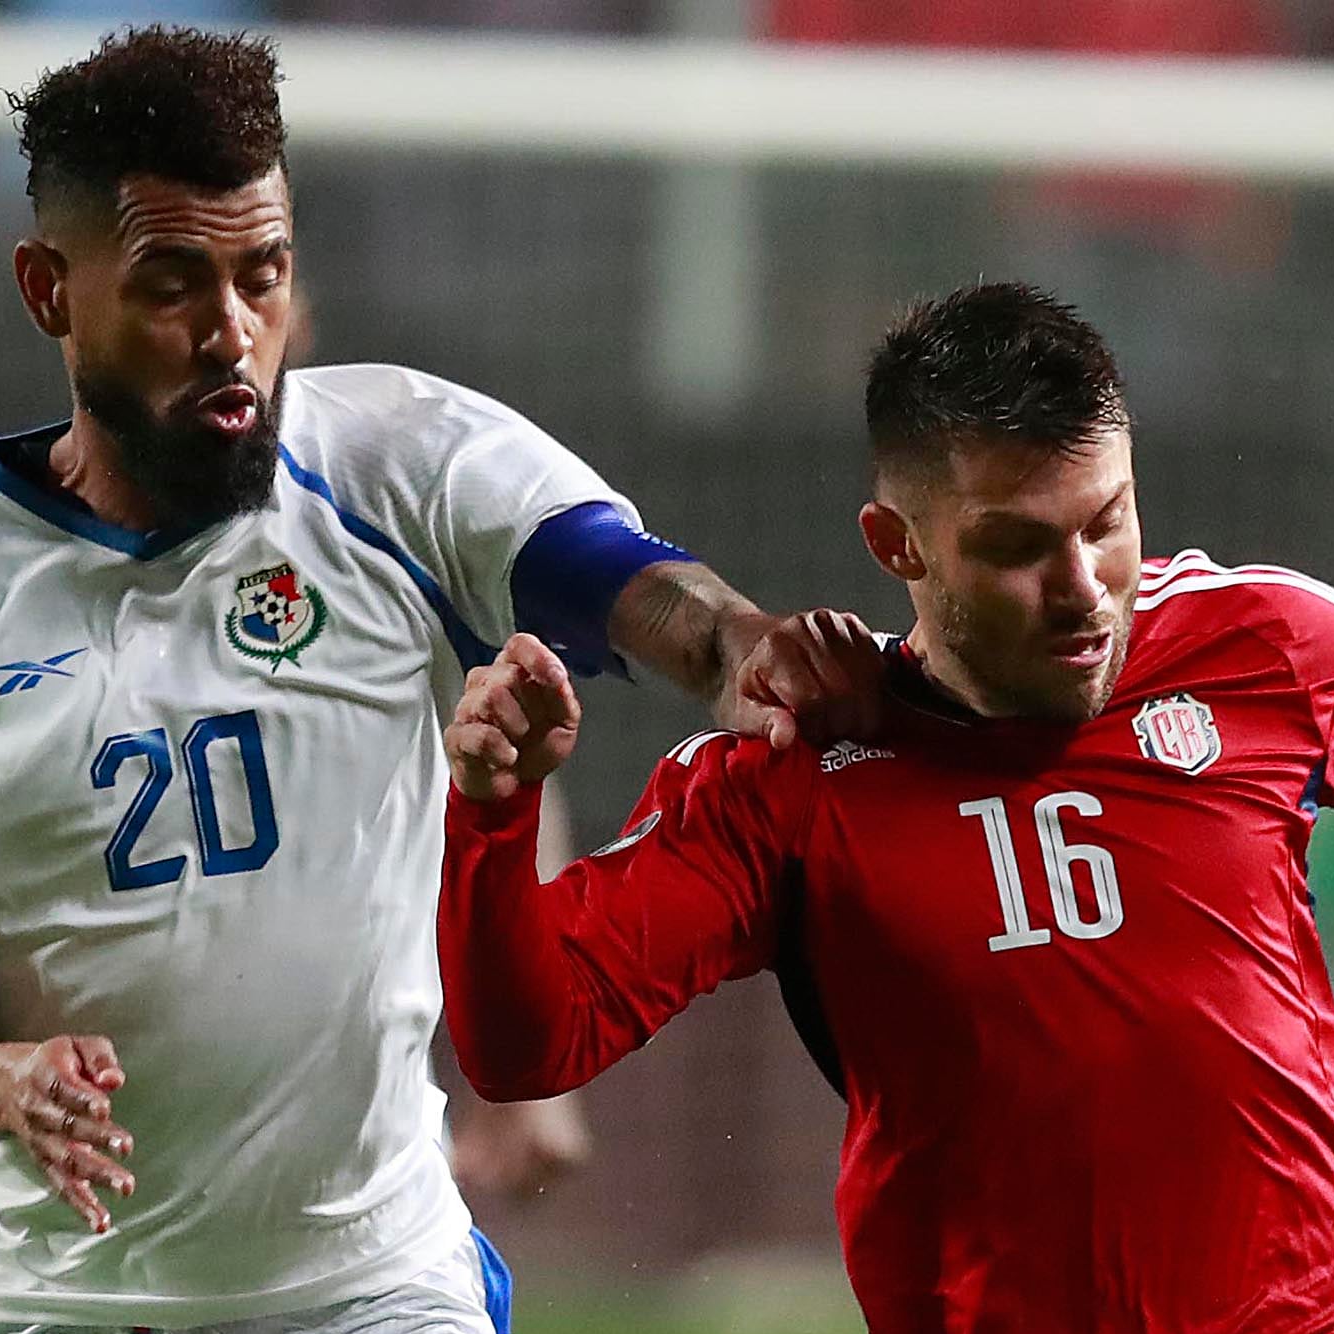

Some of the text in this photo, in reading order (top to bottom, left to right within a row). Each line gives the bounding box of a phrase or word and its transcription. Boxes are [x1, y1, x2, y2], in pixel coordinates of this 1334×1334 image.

[90, 710, 280, 892] 20
[1150, 708, 1204, 761] CR
[959, 791, 1124, 952] 16
